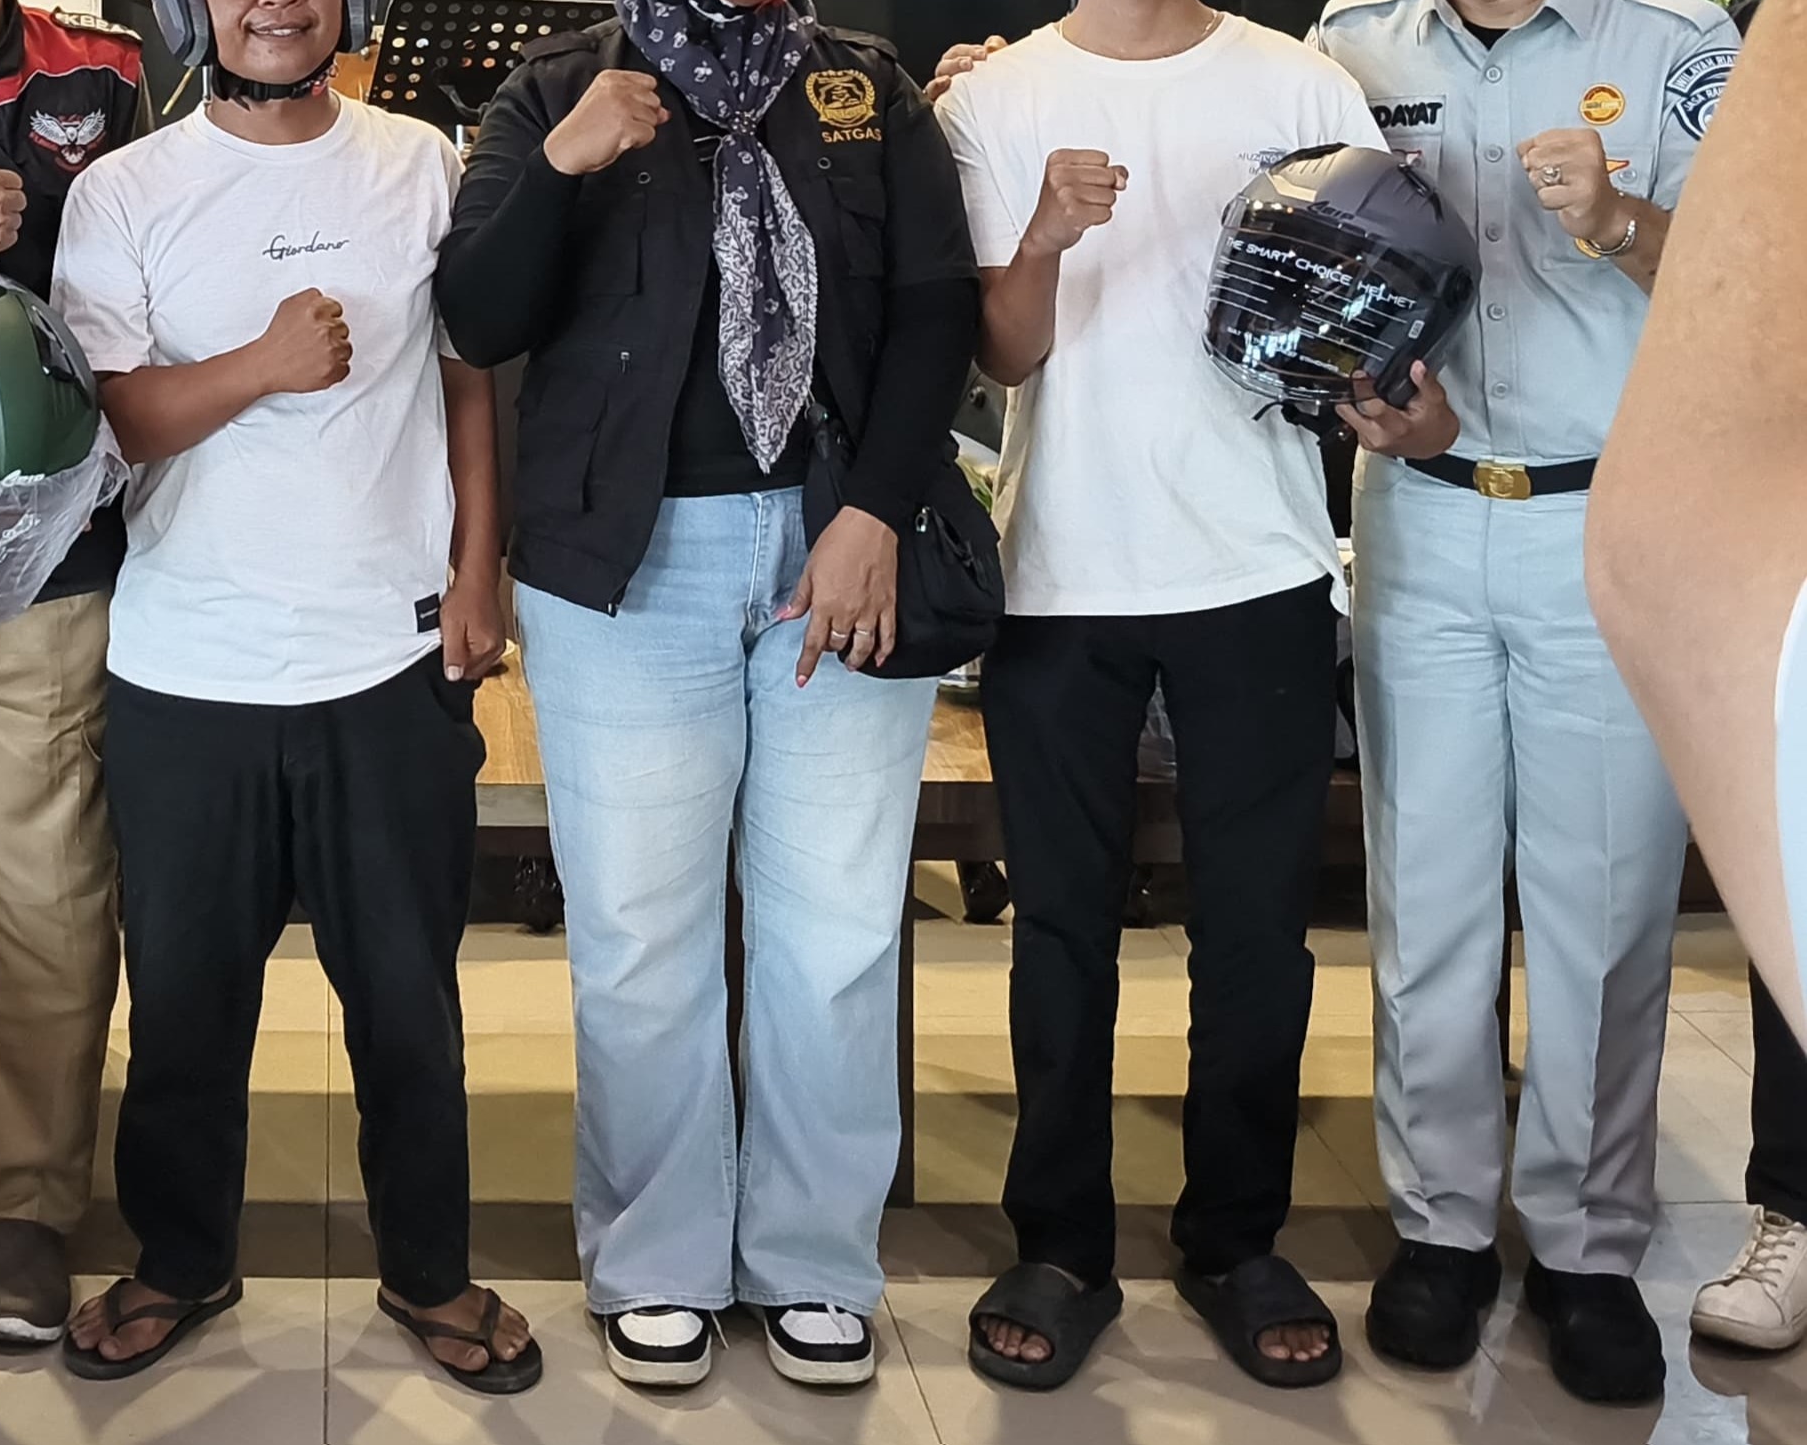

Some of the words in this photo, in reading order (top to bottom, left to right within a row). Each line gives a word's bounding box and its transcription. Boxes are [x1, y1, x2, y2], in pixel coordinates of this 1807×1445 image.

[1369, 102, 1444, 129] DAYAT
[821, 127, 882, 143] SATGAS
[262, 230, 350, 260] Giordano
[1246, 243, 1291, 264] SMART
[1295, 258, 1353, 286] CHOICE
[1357, 280, 1418, 310] HELMET
